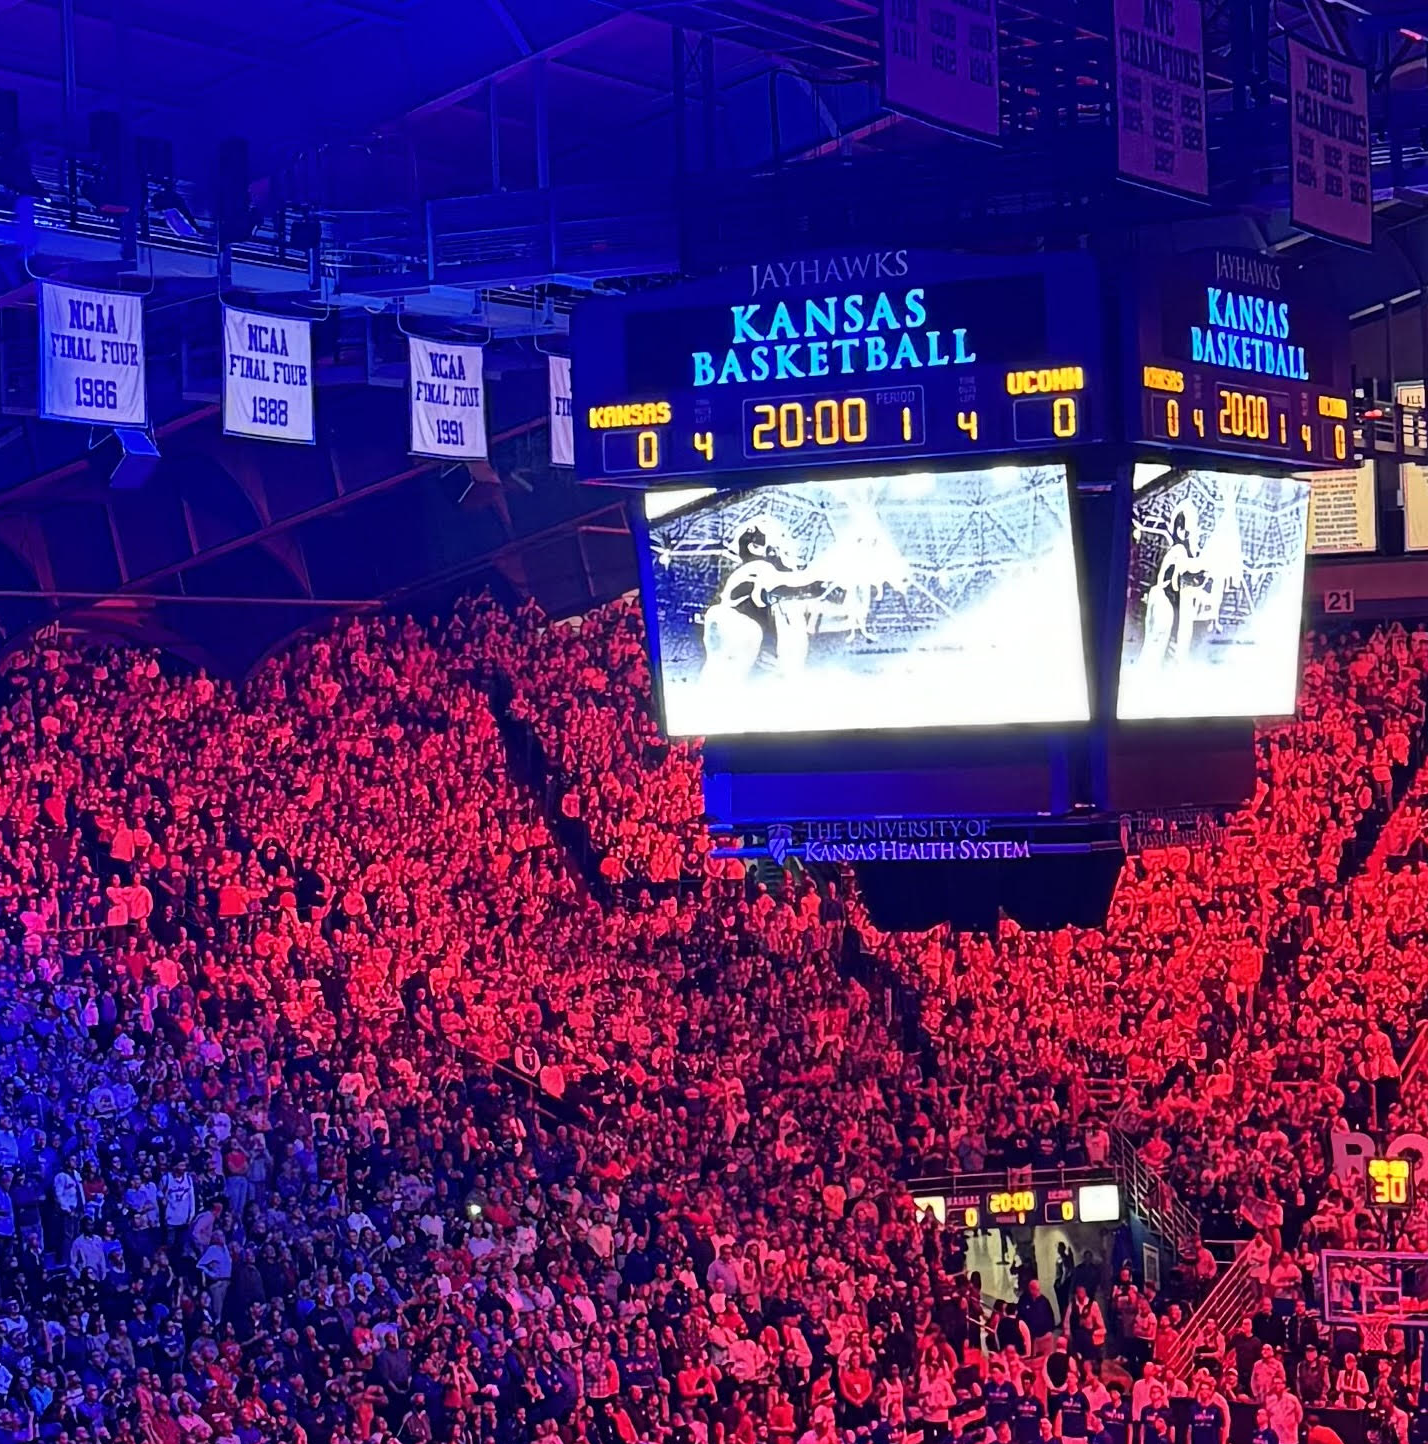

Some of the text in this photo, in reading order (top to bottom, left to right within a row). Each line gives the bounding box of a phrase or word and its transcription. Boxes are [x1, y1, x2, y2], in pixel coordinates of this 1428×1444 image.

[1295, 90, 1368, 147] CHAMPIONS
[750, 249, 909, 297] JAYHAWKS
[1215, 251, 1281, 290] JAYHAWKS
[69, 299, 118, 334] NCAA
[730, 288, 927, 344] KANSAS
[1207, 287, 1289, 339] KANSAS
[51, 332, 138, 367] FINAL FOUR
[248, 324, 289, 357] NCAA
[1190, 326, 1310, 381] BASKETBALL
[230, 354, 307, 386] FINAL FOUR
[429, 352, 466, 380] NCAA
[691, 328, 977, 387] BASKETBALL
[75, 377, 117, 409] 1986
[416, 381, 479, 407] FINAL FOUR
[1006, 366, 1084, 395] UCONN
[252, 396, 288, 427] 1988
[875, 391, 916, 406] PERIOD
[589, 402, 672, 429] KANSAS
[753, 398, 867, 450] 20:00
[901, 407, 912, 441] 1
[957, 411, 978, 441] 4
[1052, 397, 1076, 438] 0
[1167, 399, 1180, 437] 0
[1193, 408, 1205, 438] 4
[1220, 390, 1270, 440] 20:00
[1279, 413, 1287, 444] 1
[436, 419, 465, 446] 1991
[693, 431, 713, 461] 4
[1301, 424, 1312, 452] 4
[1334, 424, 1346, 460] 0
[638, 431, 658, 468] 0
[1328, 592, 1352, 611] 21
[803, 819, 992, 840] THE UNIVERSITY OF
[803, 840, 1031, 862] KANSAS HEALTH SYSTEM
[989, 1190, 1036, 1214] 20:00
[1374, 1176, 1408, 1204] 30
[964, 1207, 978, 1227] 0
[1061, 1201, 1075, 1221] 0
